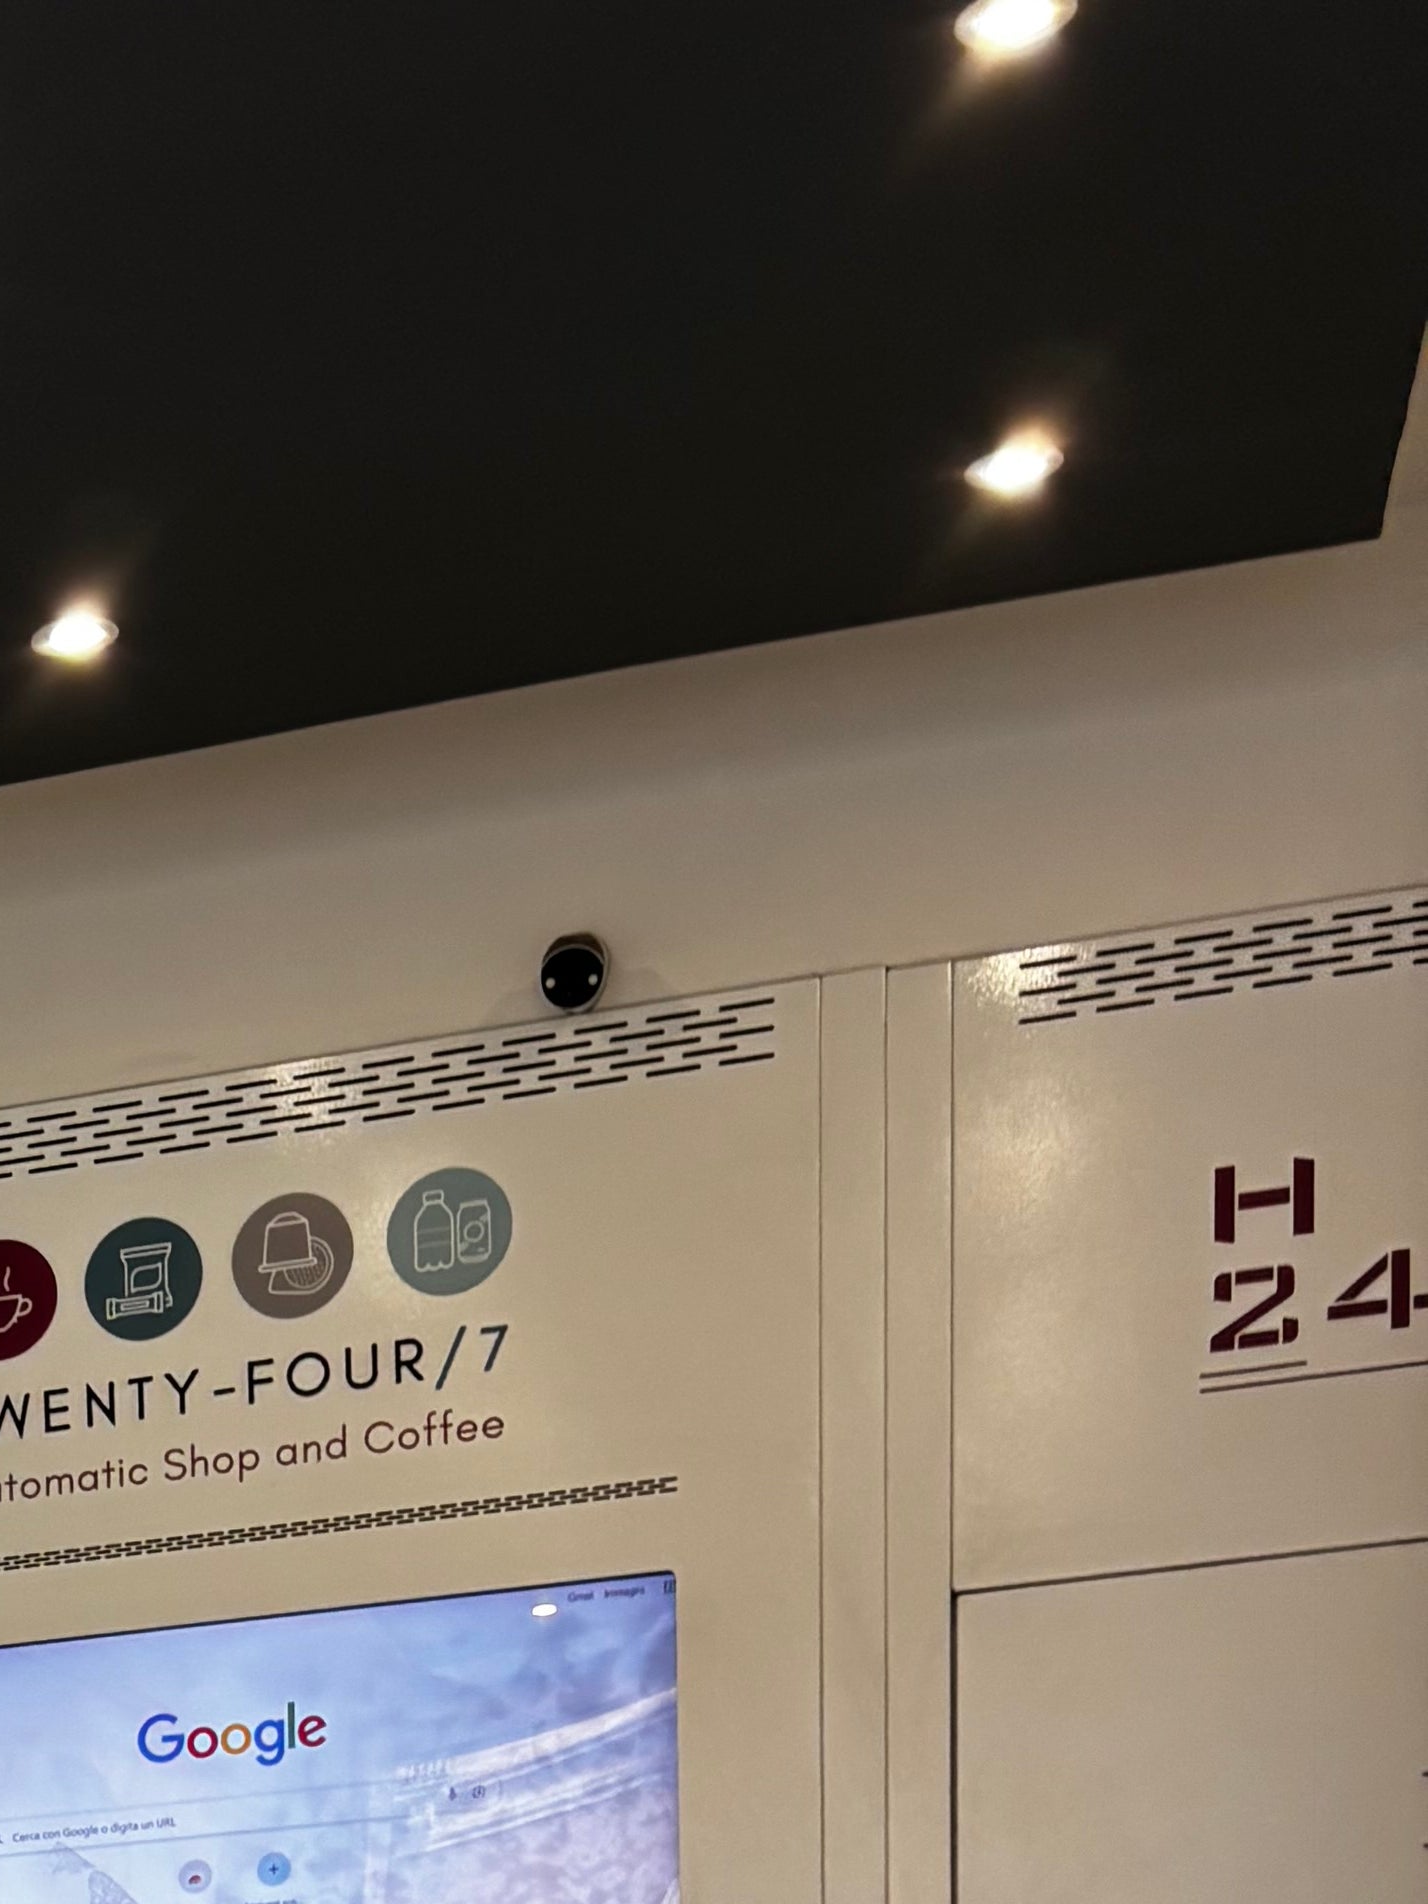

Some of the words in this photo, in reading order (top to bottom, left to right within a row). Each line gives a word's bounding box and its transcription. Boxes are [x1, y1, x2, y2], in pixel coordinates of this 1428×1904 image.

[1214, 1157, 1314, 1243] H
[162, 1442, 261, 1491] Shop
[275, 1424, 347, 1466] and
[362, 1409, 505, 1455] Coffee
[137, 1702, 328, 1767] Google
[12, 1830, 40, 1843] Cerca
[43, 1829, 61, 1840] con
[62, 1825, 99, 1839] Google
[110, 1821, 139, 1836] digita
[156, 1817, 176, 1829] URL
